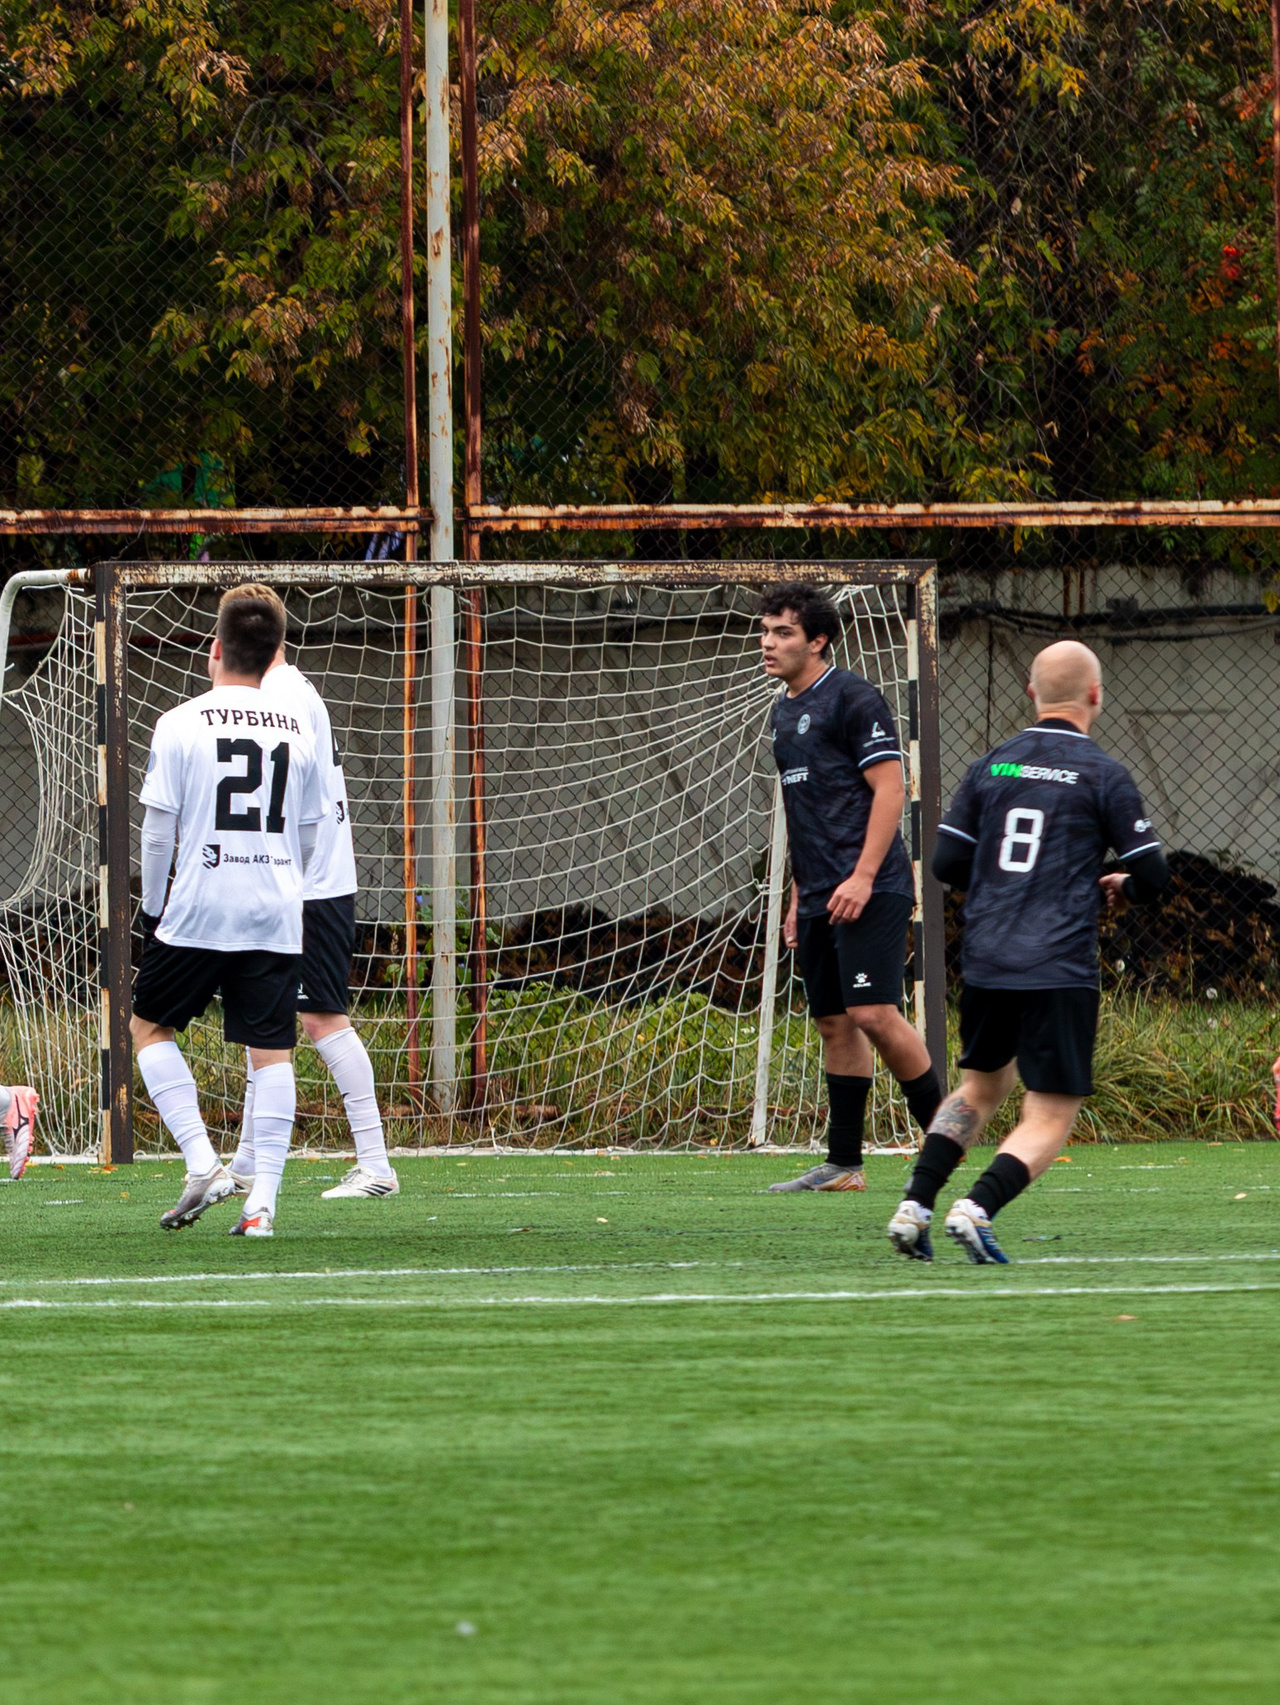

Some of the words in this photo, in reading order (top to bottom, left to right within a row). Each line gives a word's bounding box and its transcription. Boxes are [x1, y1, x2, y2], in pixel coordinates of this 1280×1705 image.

[201, 709, 301, 735] ТУРБИНА
[215, 738, 290, 834] 21
[223, 853, 250, 865] Завод
[998, 807, 1044, 873] 8
